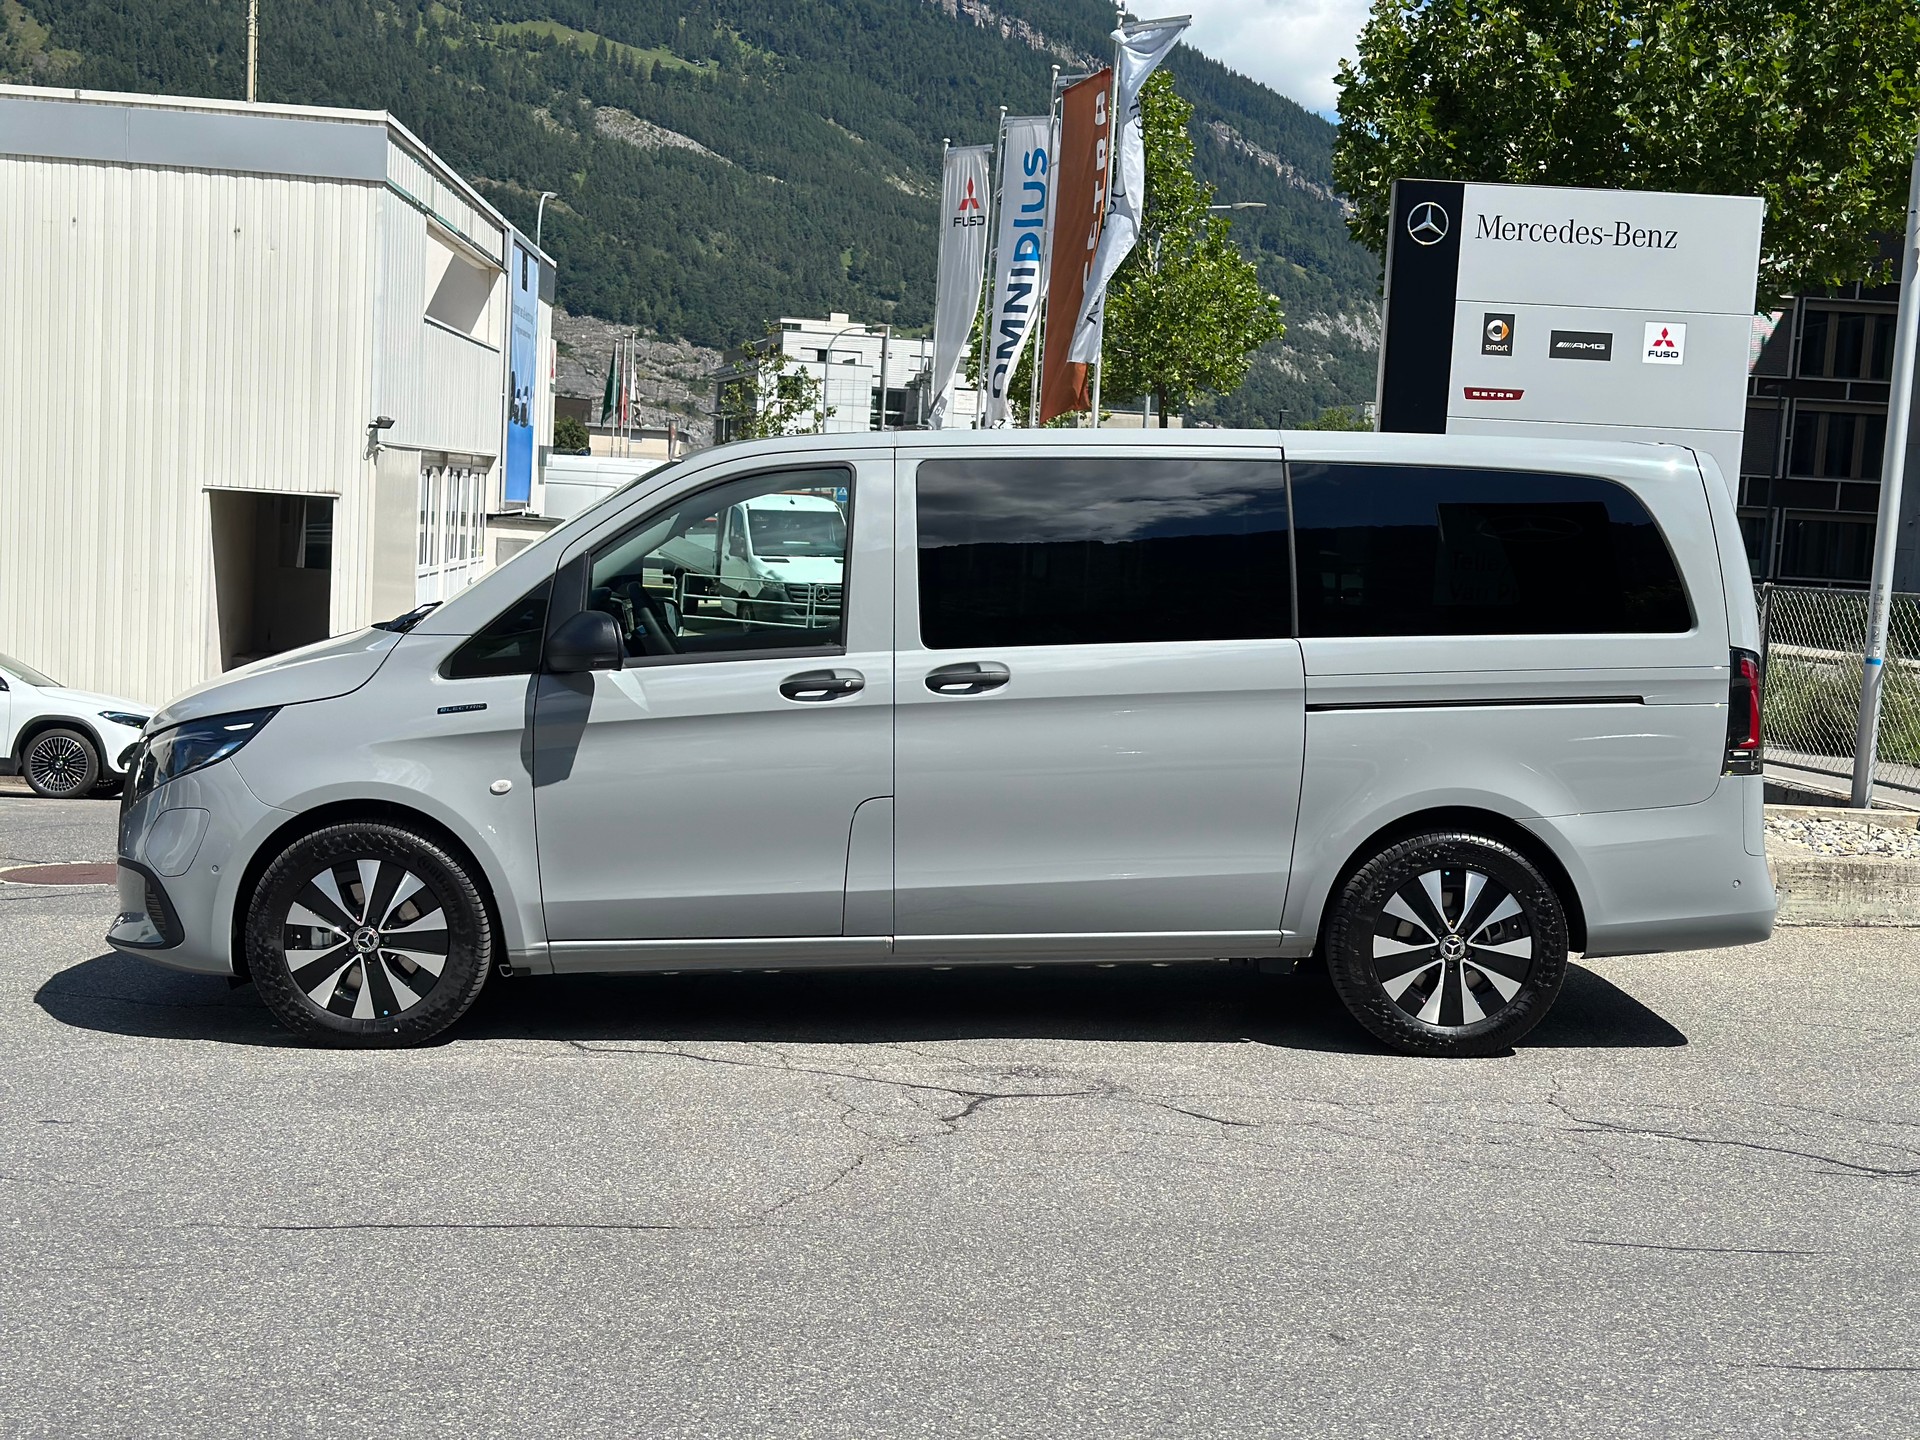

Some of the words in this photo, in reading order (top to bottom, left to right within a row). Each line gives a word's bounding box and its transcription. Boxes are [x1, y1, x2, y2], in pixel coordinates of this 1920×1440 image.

[953, 215, 985, 227] FUSO
[1475, 213, 1678, 249] Mercedes-Benz
[992, 147, 1048, 398] OMNIDIUS
[1647, 349, 1679, 358] FUSO
